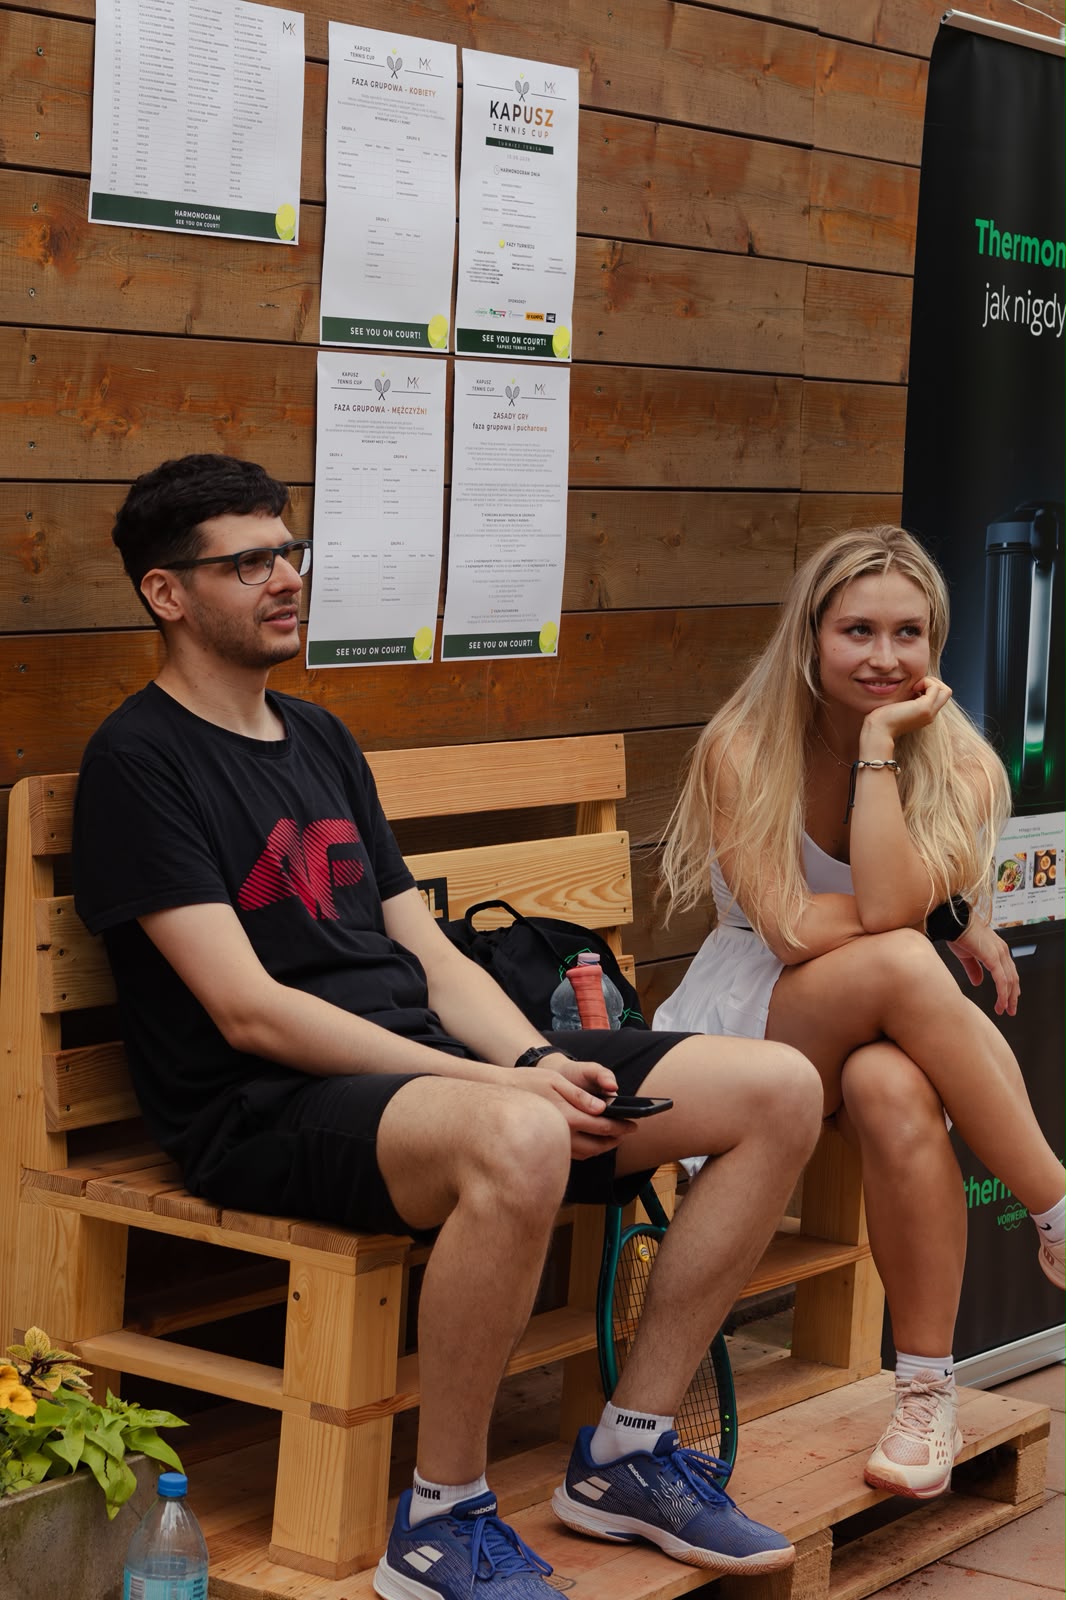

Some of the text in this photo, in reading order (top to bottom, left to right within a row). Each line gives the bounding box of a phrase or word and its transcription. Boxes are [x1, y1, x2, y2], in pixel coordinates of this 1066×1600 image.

[354, 44, 371, 53] KAPUSZ
[350, 51, 366, 60] TENNIS
[351, 77, 369, 87] FAZA
[370, 80, 403, 92] GRUPOWA
[409, 87, 436, 97] KOBIETY
[489, 100, 554, 128] KAPUSZ
[492, 123, 549, 138] TENNIS CUP
[174, 209, 221, 222] HARMONOGRAM
[982, 282, 1066, 338] jak nigdy
[350, 327, 421, 339] SEE YOU ON COURT!
[482, 334, 547, 346] SEE YOU ON COURT!
[333, 404, 351, 412] FAZA
[352, 404, 386, 413] GRUPOWA
[493, 412, 516, 420] ZASADY
[472, 422, 485, 430] faza
[486, 424, 512, 432] grupowa
[468, 641, 481, 649] SEE
[498, 640, 508, 648] ON
[509, 639, 533, 647] COURT!
[335, 645, 407, 656] SEE YOU ON COURT!
[996, 1207, 1028, 1226] VORWERK
[615, 1414, 657, 1431] PUMA
[414, 1481, 441, 1500] UMA
